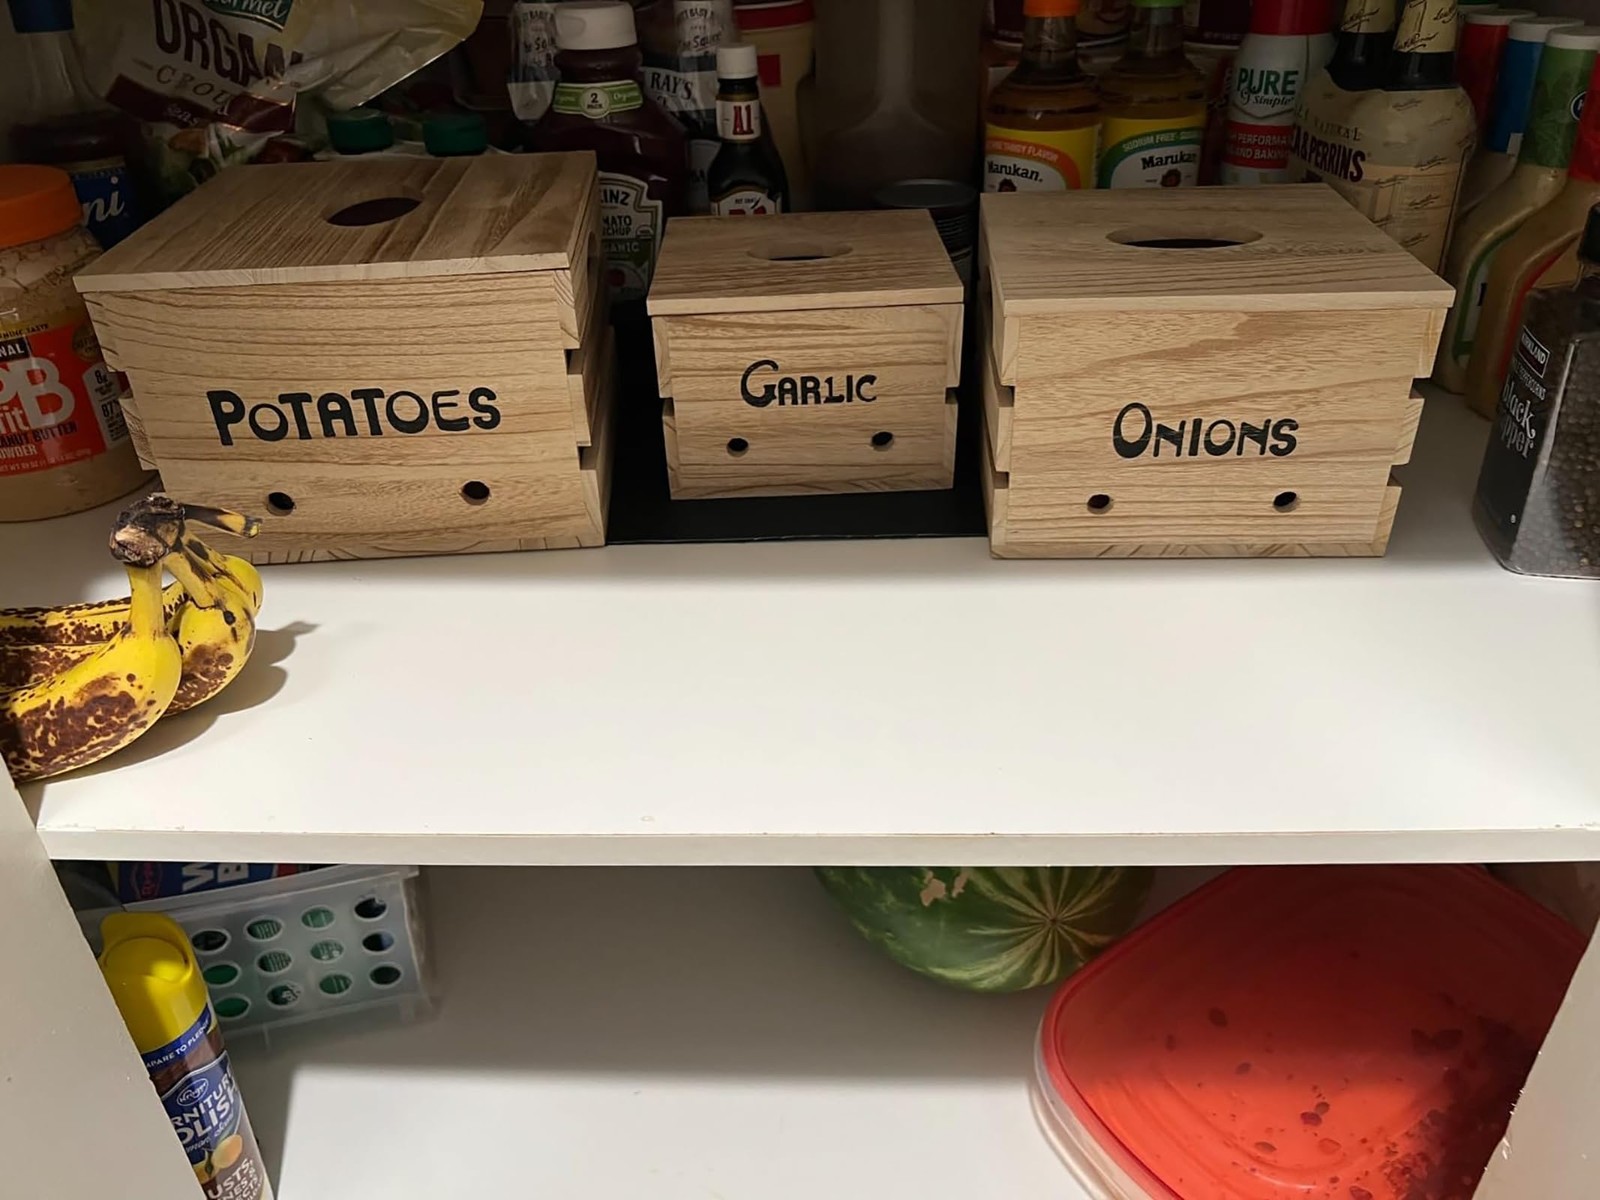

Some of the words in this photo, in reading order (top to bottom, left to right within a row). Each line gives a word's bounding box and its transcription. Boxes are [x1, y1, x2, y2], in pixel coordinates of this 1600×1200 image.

[651, 72, 693, 100] RAY'S
[1237, 68, 1299, 96] PURE
[591, 92, 600, 104] 2
[1252, 95, 1291, 109] Simple
[1308, 135, 1366, 183] PERRINS
[206, 386, 501, 446] POTATOES
[32, 421, 78, 442] BUTTER
[175, 1044, 188, 1055] TO
